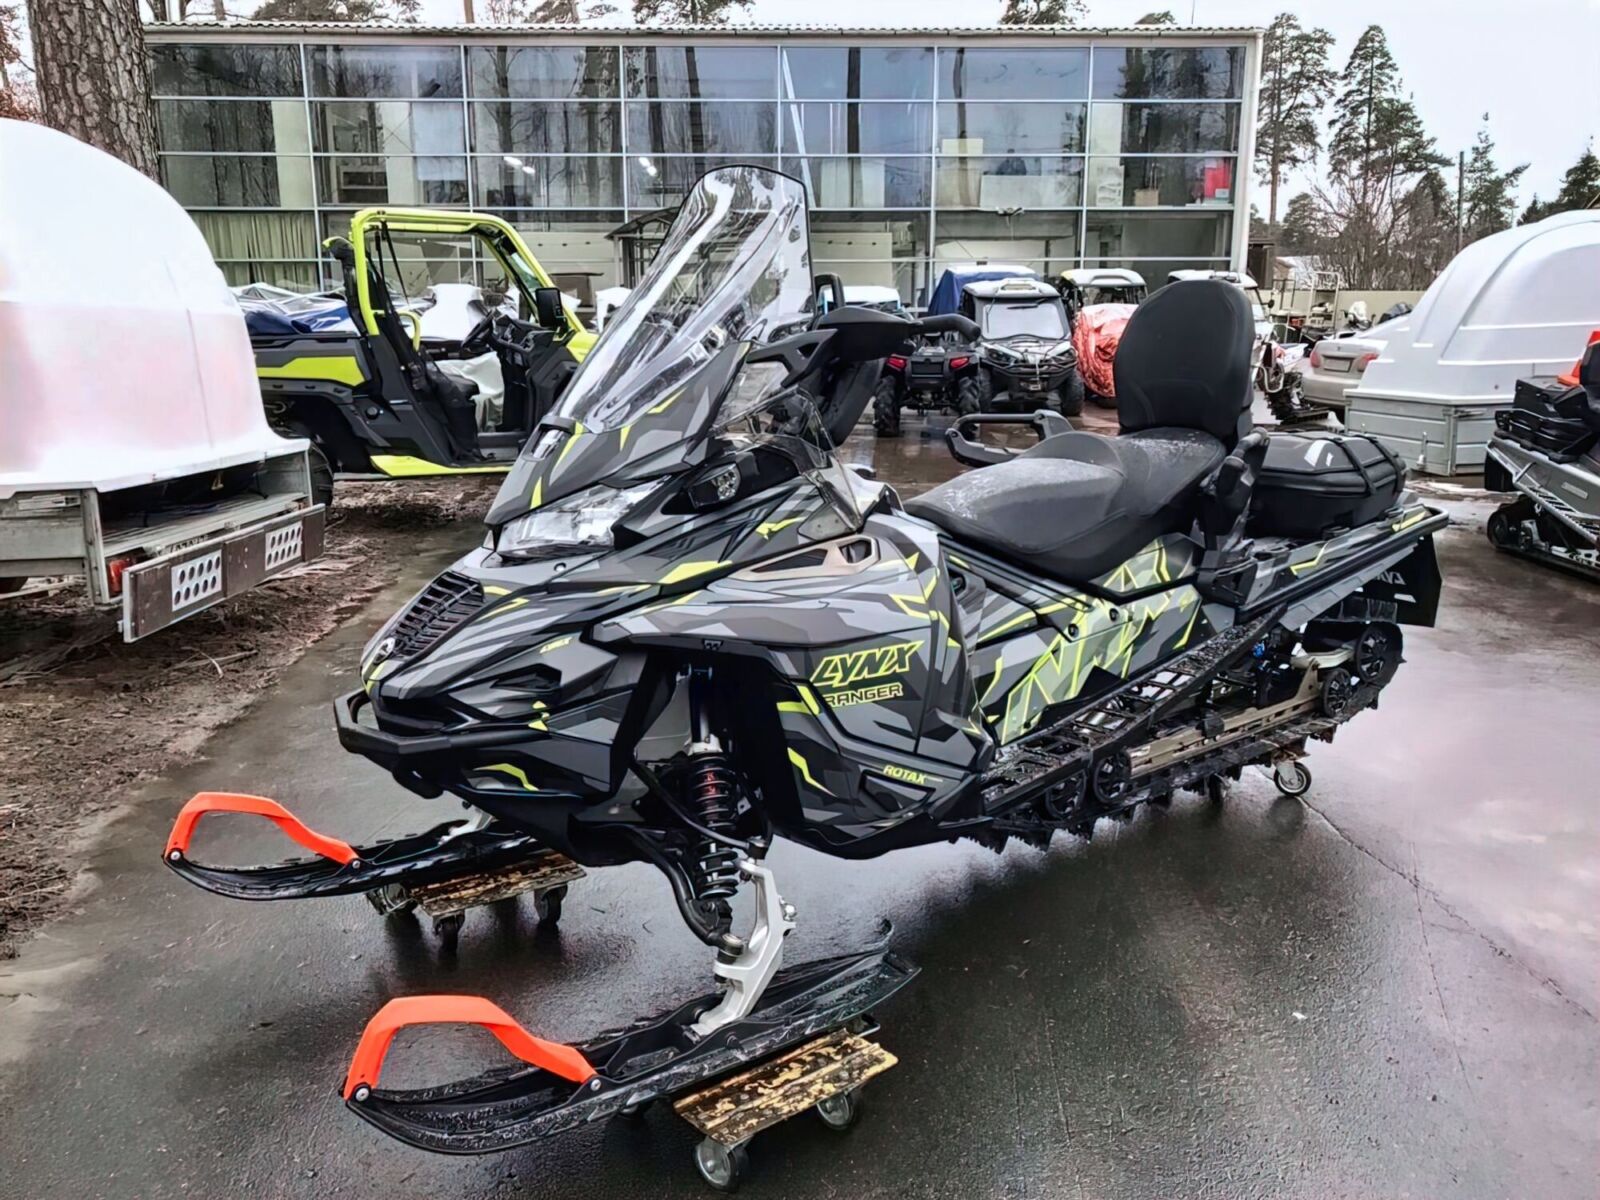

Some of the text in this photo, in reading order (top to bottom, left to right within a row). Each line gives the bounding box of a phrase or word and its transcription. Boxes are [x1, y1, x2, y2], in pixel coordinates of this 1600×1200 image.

[809, 640, 925, 687] LYNX
[823, 682, 904, 708] RANGER
[883, 764, 930, 784] ROTAX
